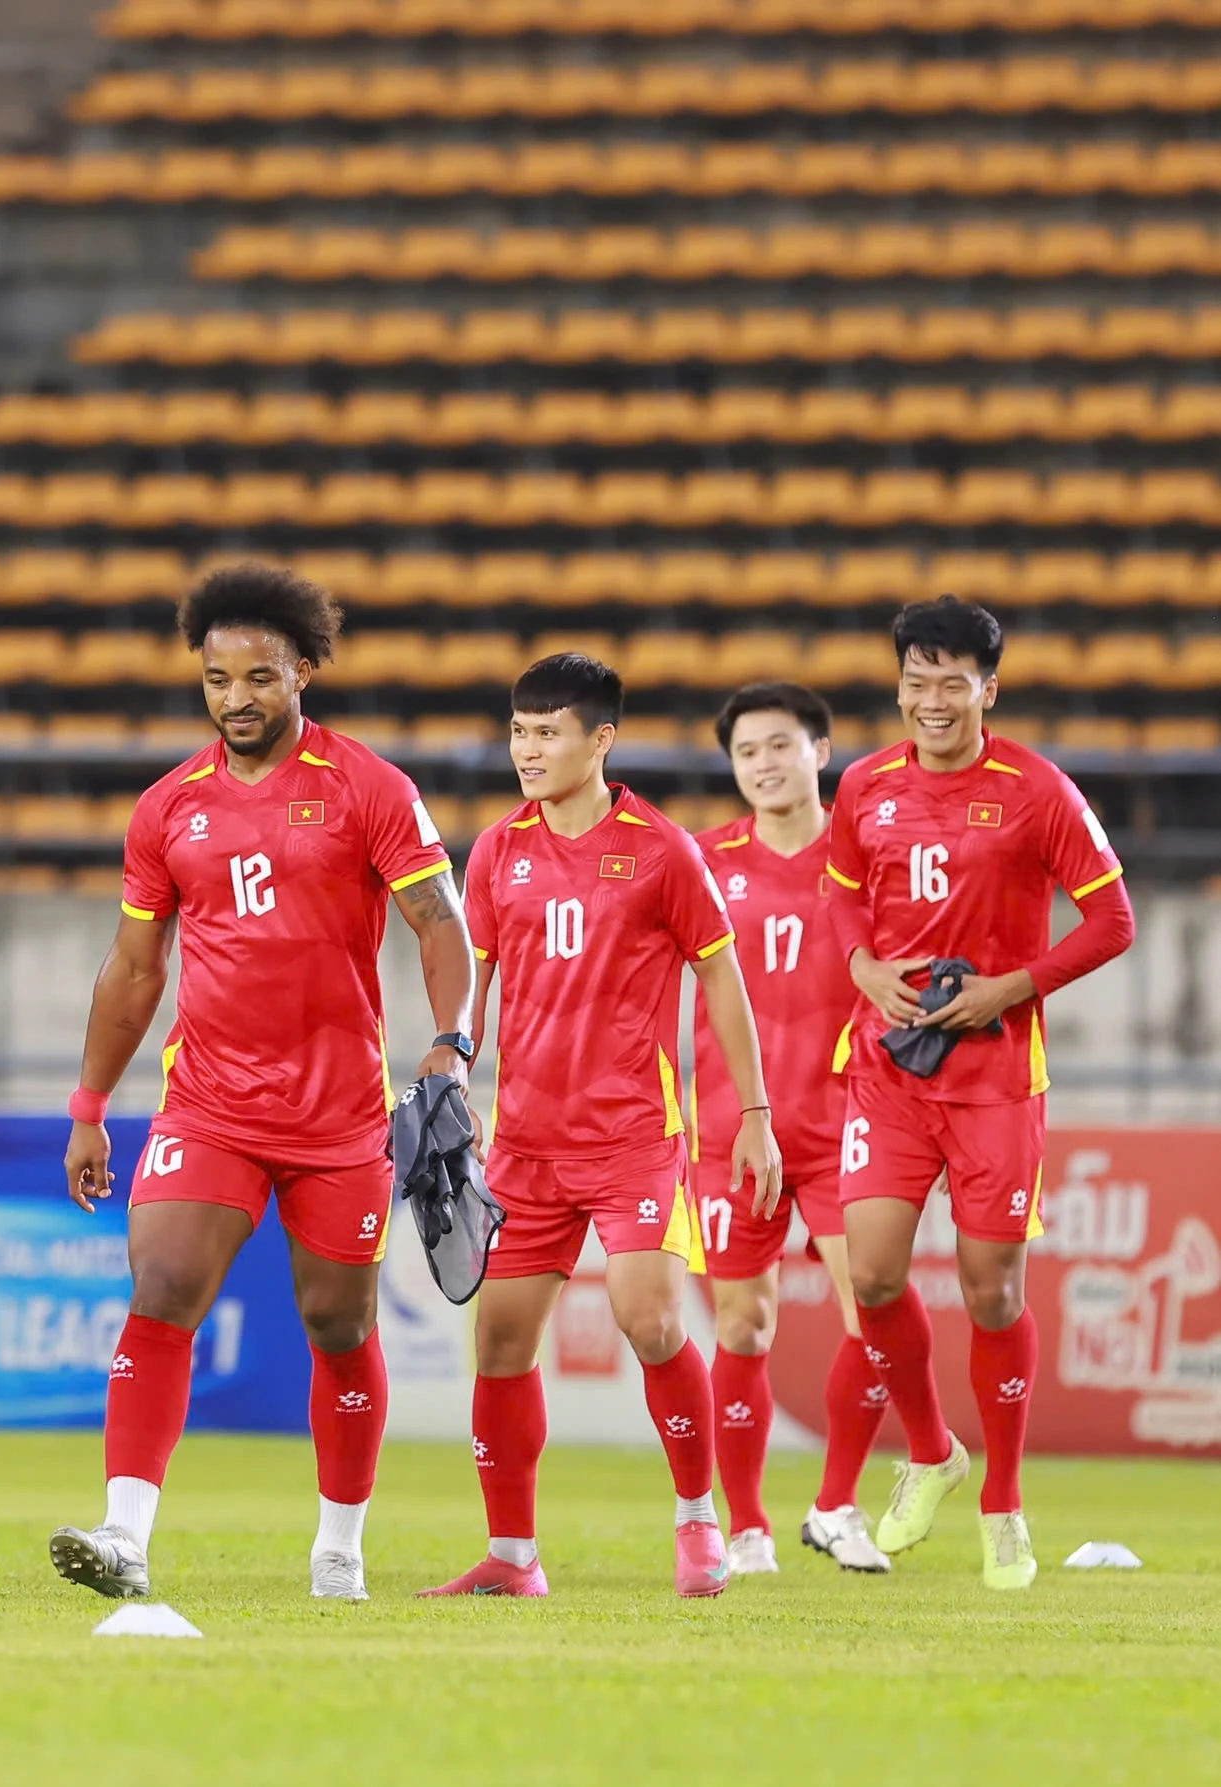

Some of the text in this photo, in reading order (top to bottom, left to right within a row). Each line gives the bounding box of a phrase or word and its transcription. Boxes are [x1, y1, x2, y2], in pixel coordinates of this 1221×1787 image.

[229, 852, 276, 919] 12
[910, 842, 950, 904] 16
[545, 897, 584, 960] 10
[764, 914, 804, 974] 17
[701, 1196, 733, 1253] 17
